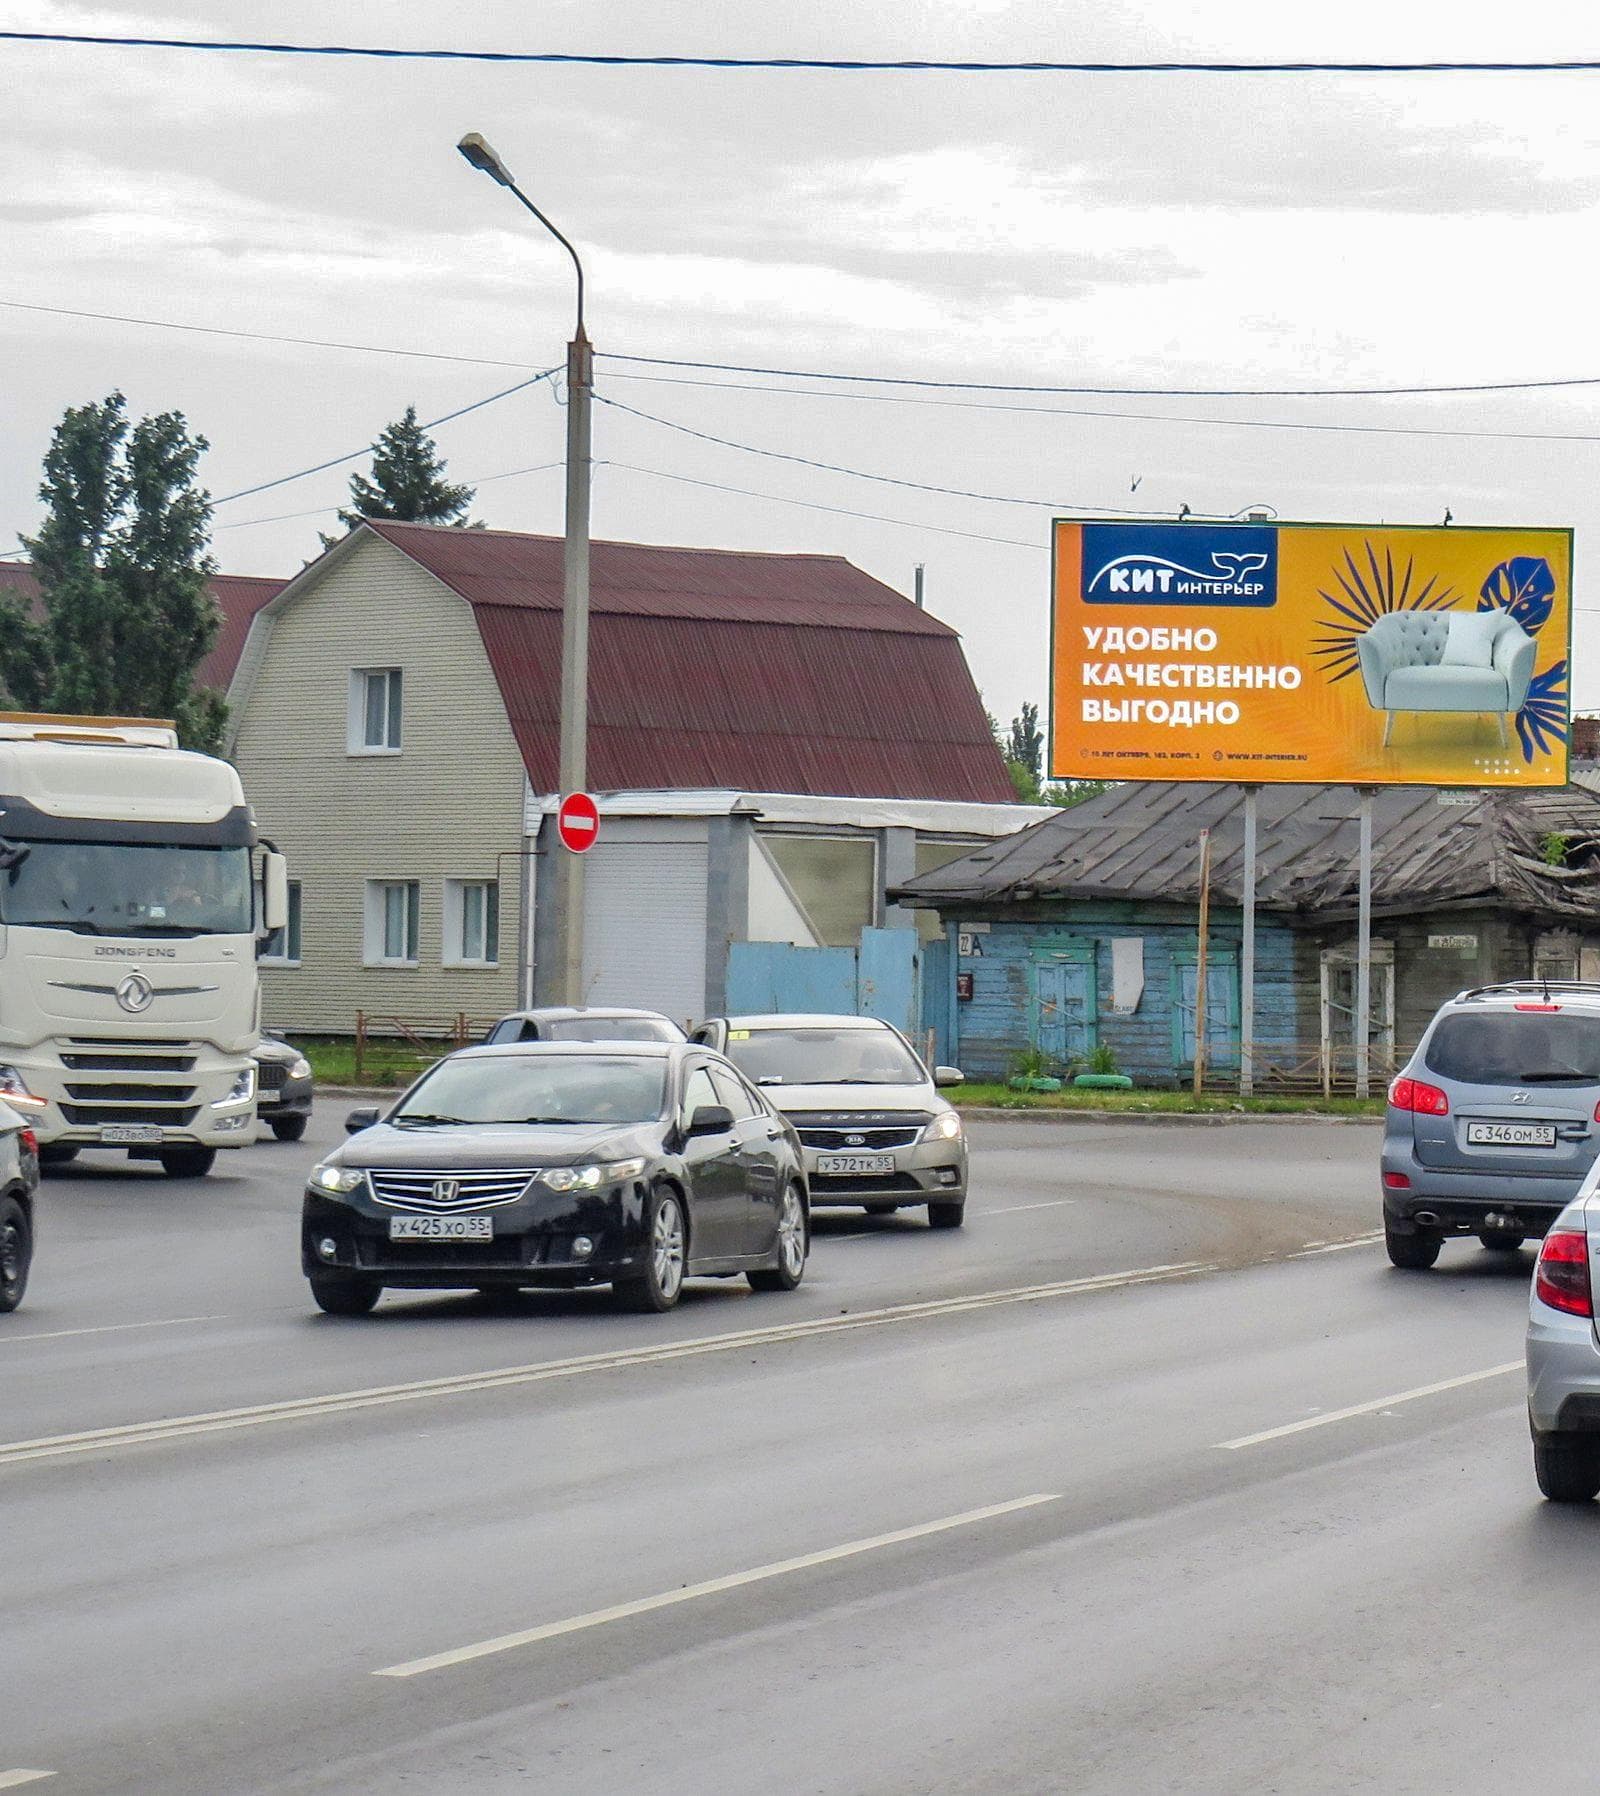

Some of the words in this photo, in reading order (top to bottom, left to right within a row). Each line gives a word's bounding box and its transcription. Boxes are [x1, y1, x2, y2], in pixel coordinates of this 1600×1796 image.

[1110, 568, 1174, 593] КИТ
[1177, 582, 1265, 596] ИНТЕРЬЕР
[1082, 626, 1218, 654] УДОБНО
[1082, 662, 1303, 690] КАЧЕСТВЕННО
[1082, 698, 1240, 728] ВЫГОДНО
[94, 946, 176, 958] DONGFENG
